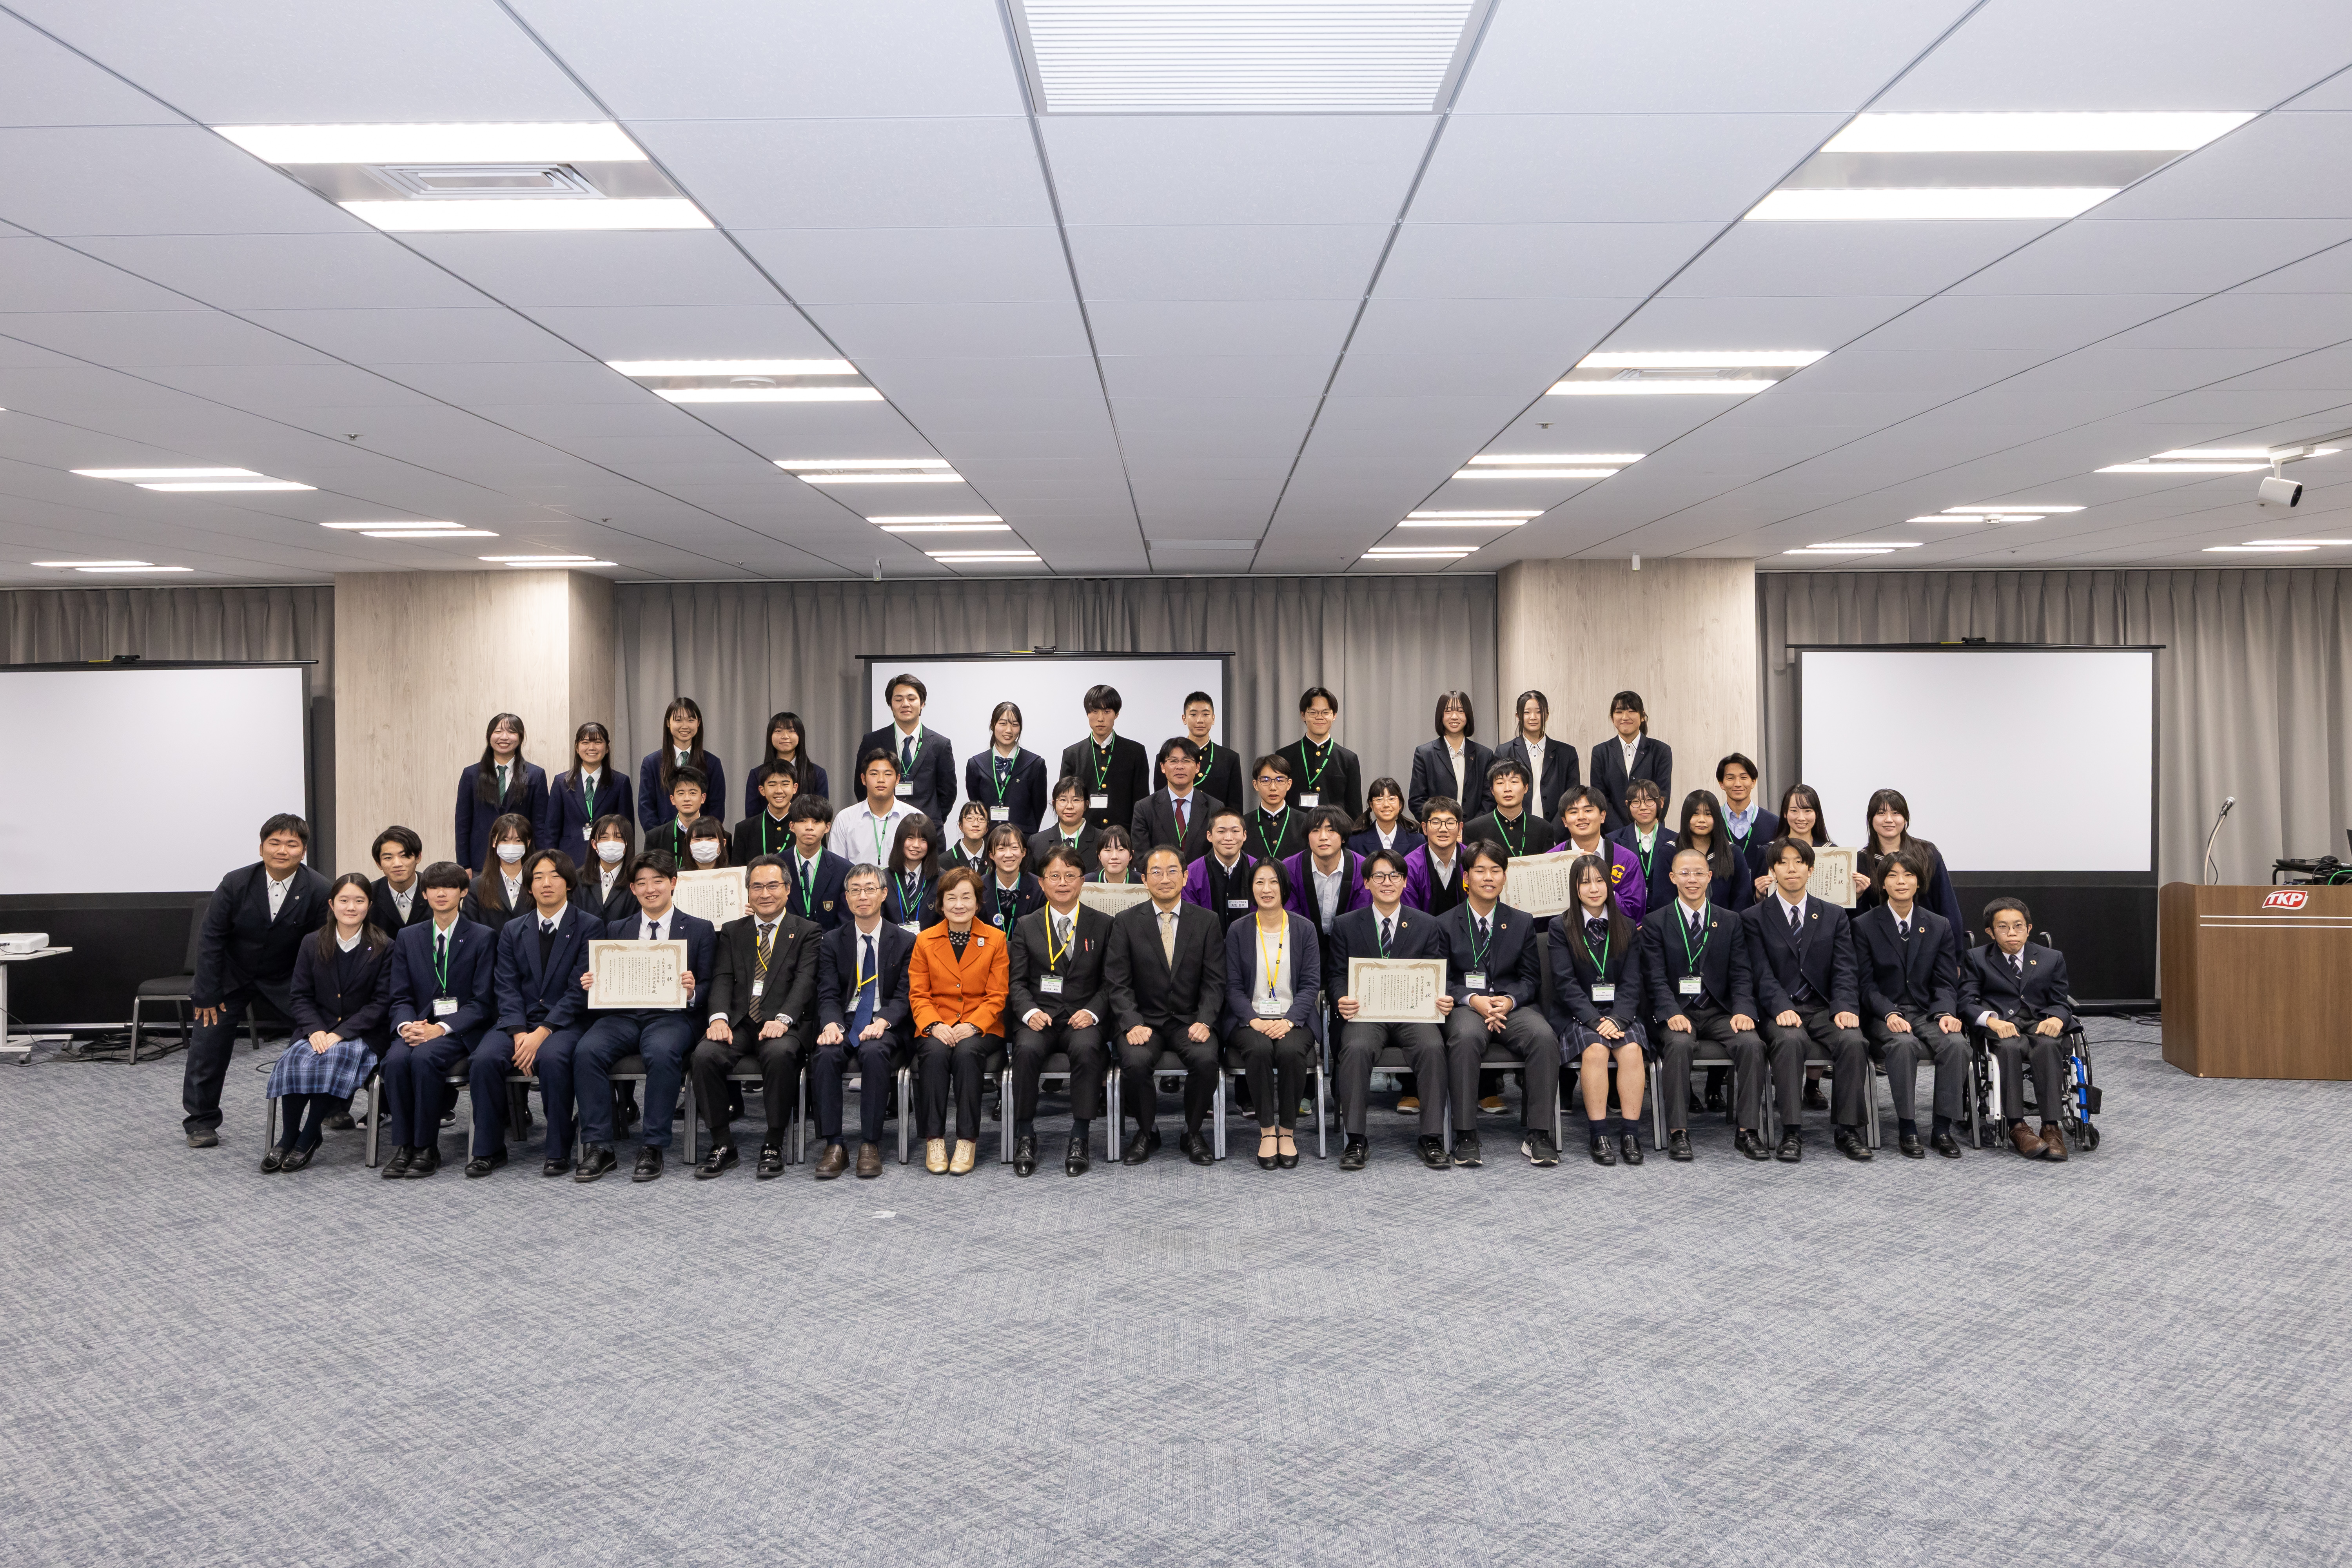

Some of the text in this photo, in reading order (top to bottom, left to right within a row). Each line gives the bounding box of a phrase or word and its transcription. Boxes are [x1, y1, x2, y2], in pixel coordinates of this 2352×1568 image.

[1838, 868, 1844, 884] 賞状
[730, 889, 735, 906] 賞状
[2268, 893, 2303, 905] TKP
[665, 964, 673, 982] 賞状
[1425, 981, 1431, 998] 賞状
